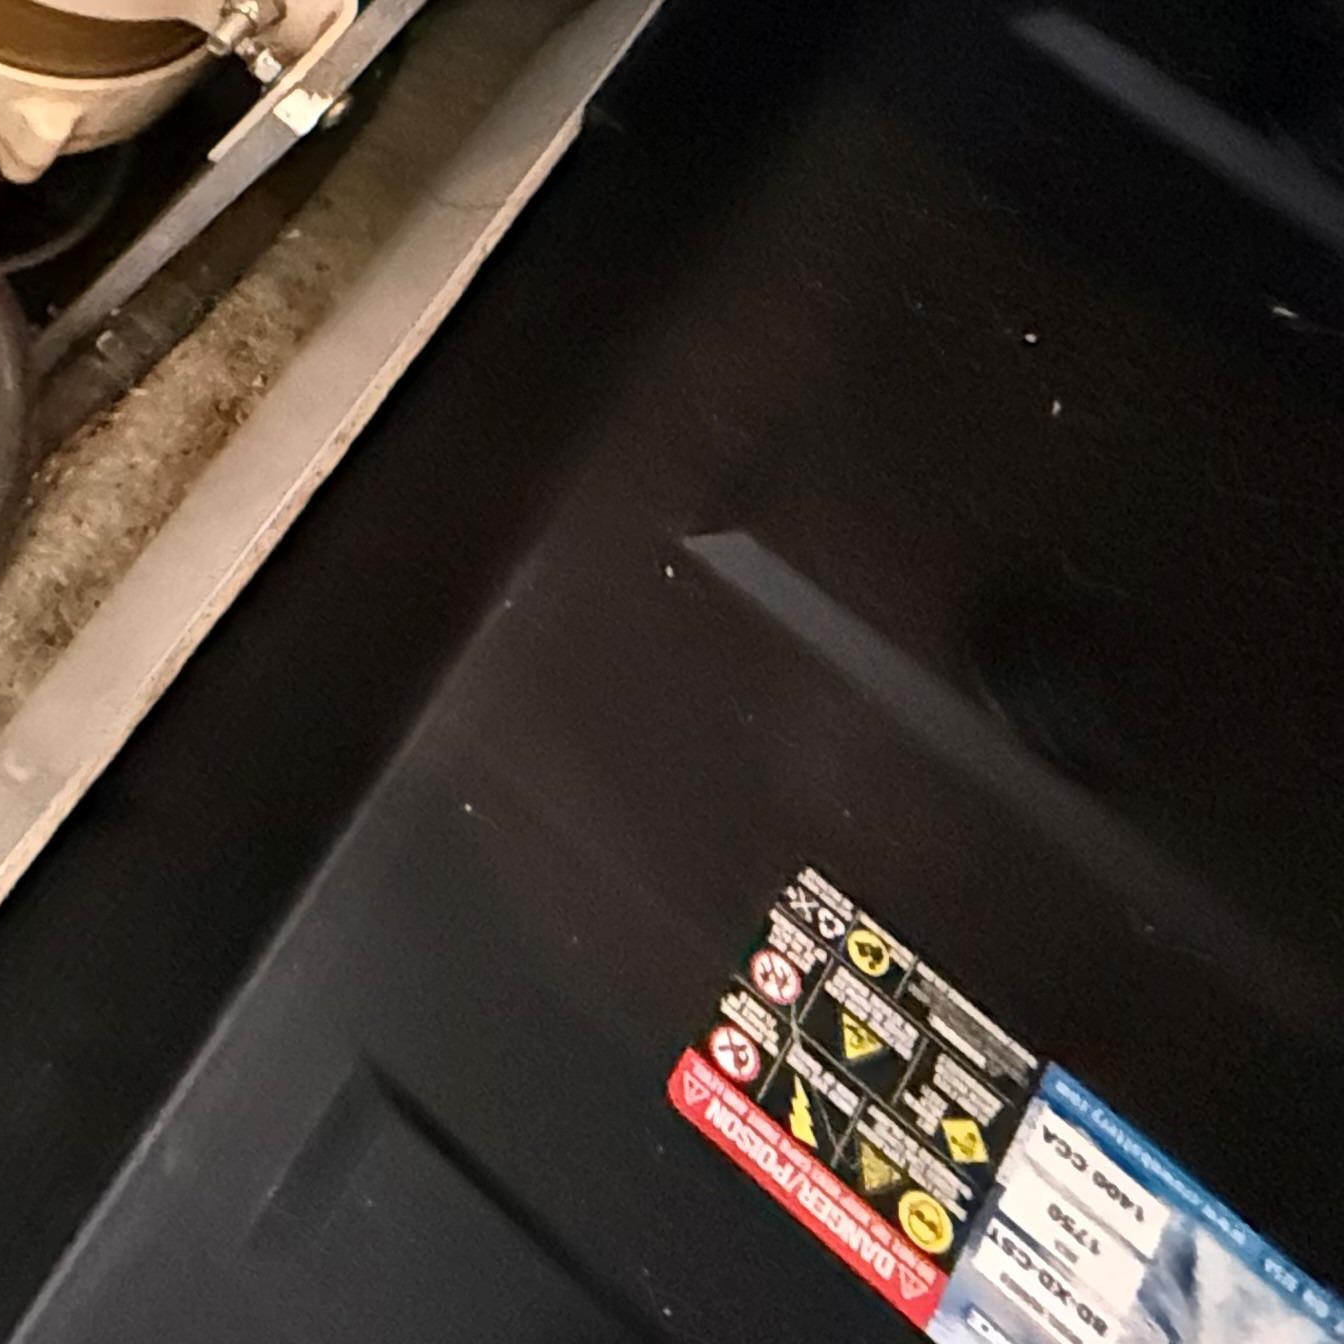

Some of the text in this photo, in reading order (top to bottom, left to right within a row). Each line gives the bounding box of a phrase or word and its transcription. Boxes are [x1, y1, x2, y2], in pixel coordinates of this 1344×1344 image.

[704, 1096, 897, 1280] DANGER/POISON
[1042, 1124, 1145, 1223] 1400 CCA
[1047, 1203, 1100, 1255] 1750
